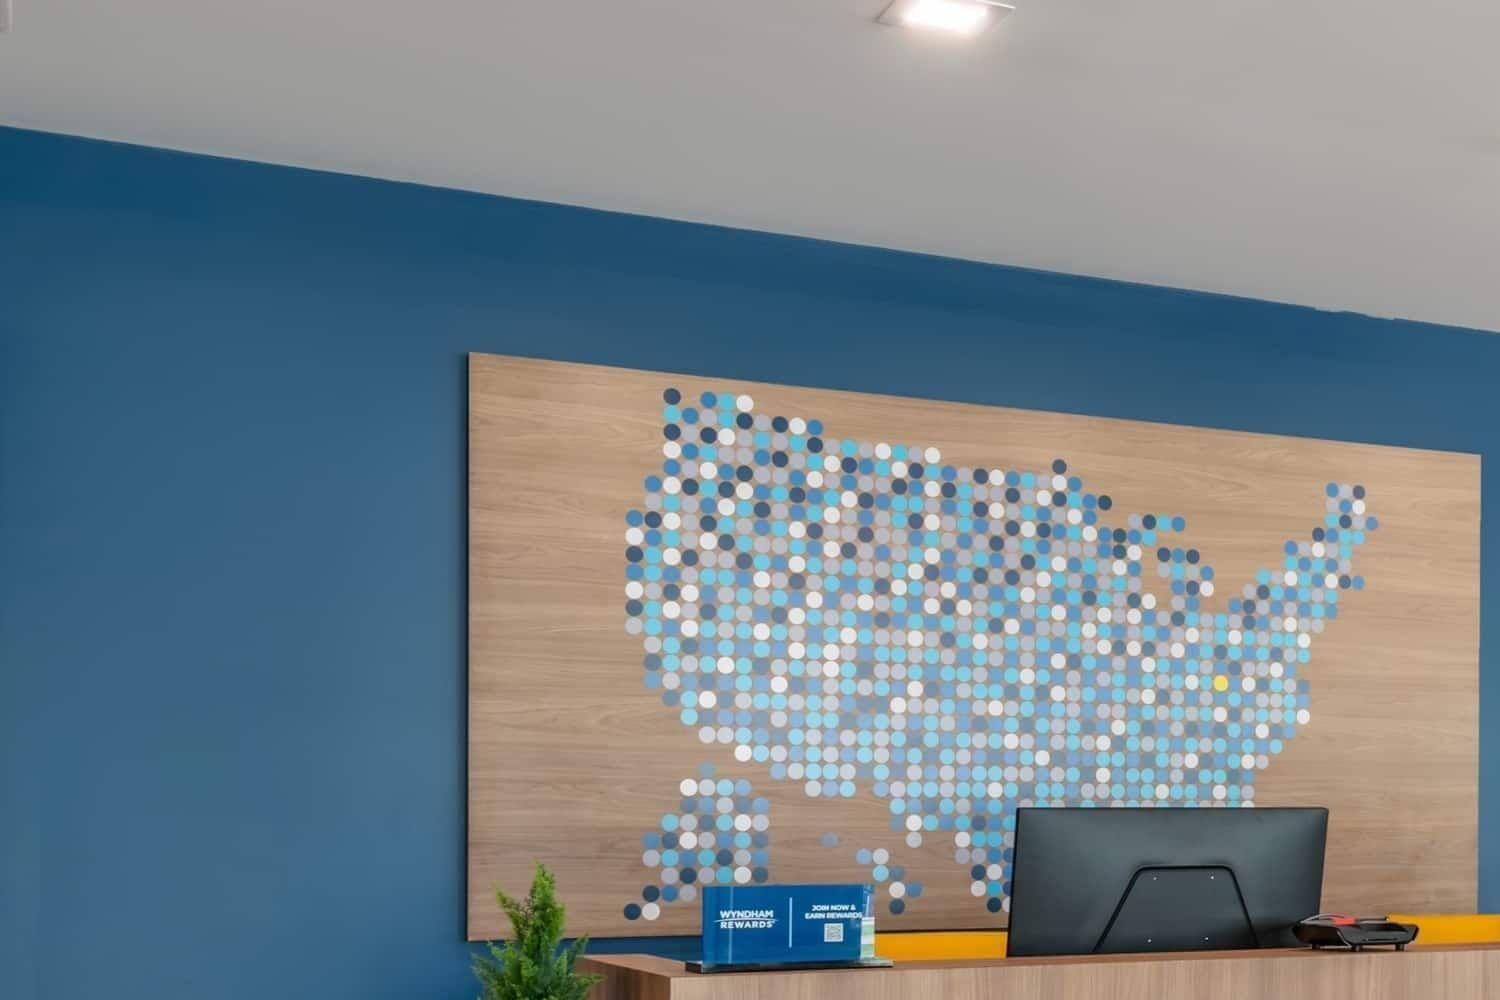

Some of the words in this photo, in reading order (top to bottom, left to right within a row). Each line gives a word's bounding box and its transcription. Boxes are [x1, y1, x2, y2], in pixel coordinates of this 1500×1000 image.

[811, 904, 829, 912] JOIN
[719, 909, 774, 919] WYNDHAM
[804, 912, 826, 920] EARN
[826, 911, 863, 919] REWARDS
